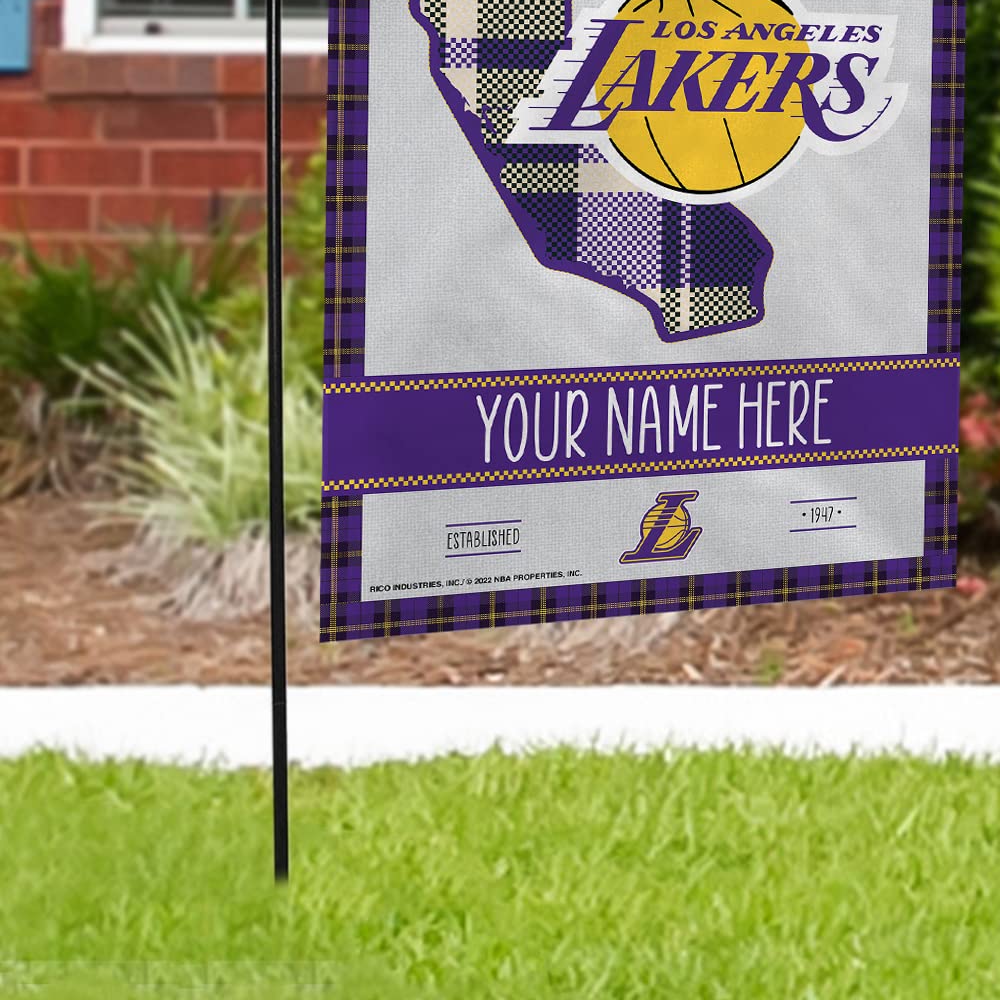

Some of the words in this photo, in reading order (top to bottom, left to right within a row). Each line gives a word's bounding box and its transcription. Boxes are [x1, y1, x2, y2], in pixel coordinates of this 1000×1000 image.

[651, 21, 720, 39] LOS
[720, 23, 884, 45] ANGELES
[528, 18, 893, 142] LAKERS
[476, 391, 590, 464] YOUR
[606, 385, 724, 456] NAME
[739, 379, 834, 449] HERE
[446, 526, 521, 550] ESTABLISHED
[369, 585, 391, 593] RICO
[393, 581, 444, 592] INDUSTRIES,
[474, 576, 492, 585] 2022
[494, 575, 511, 584] NBA
[513, 571, 565, 582] PROPERTIES,
[567, 570, 583, 578] INC.
